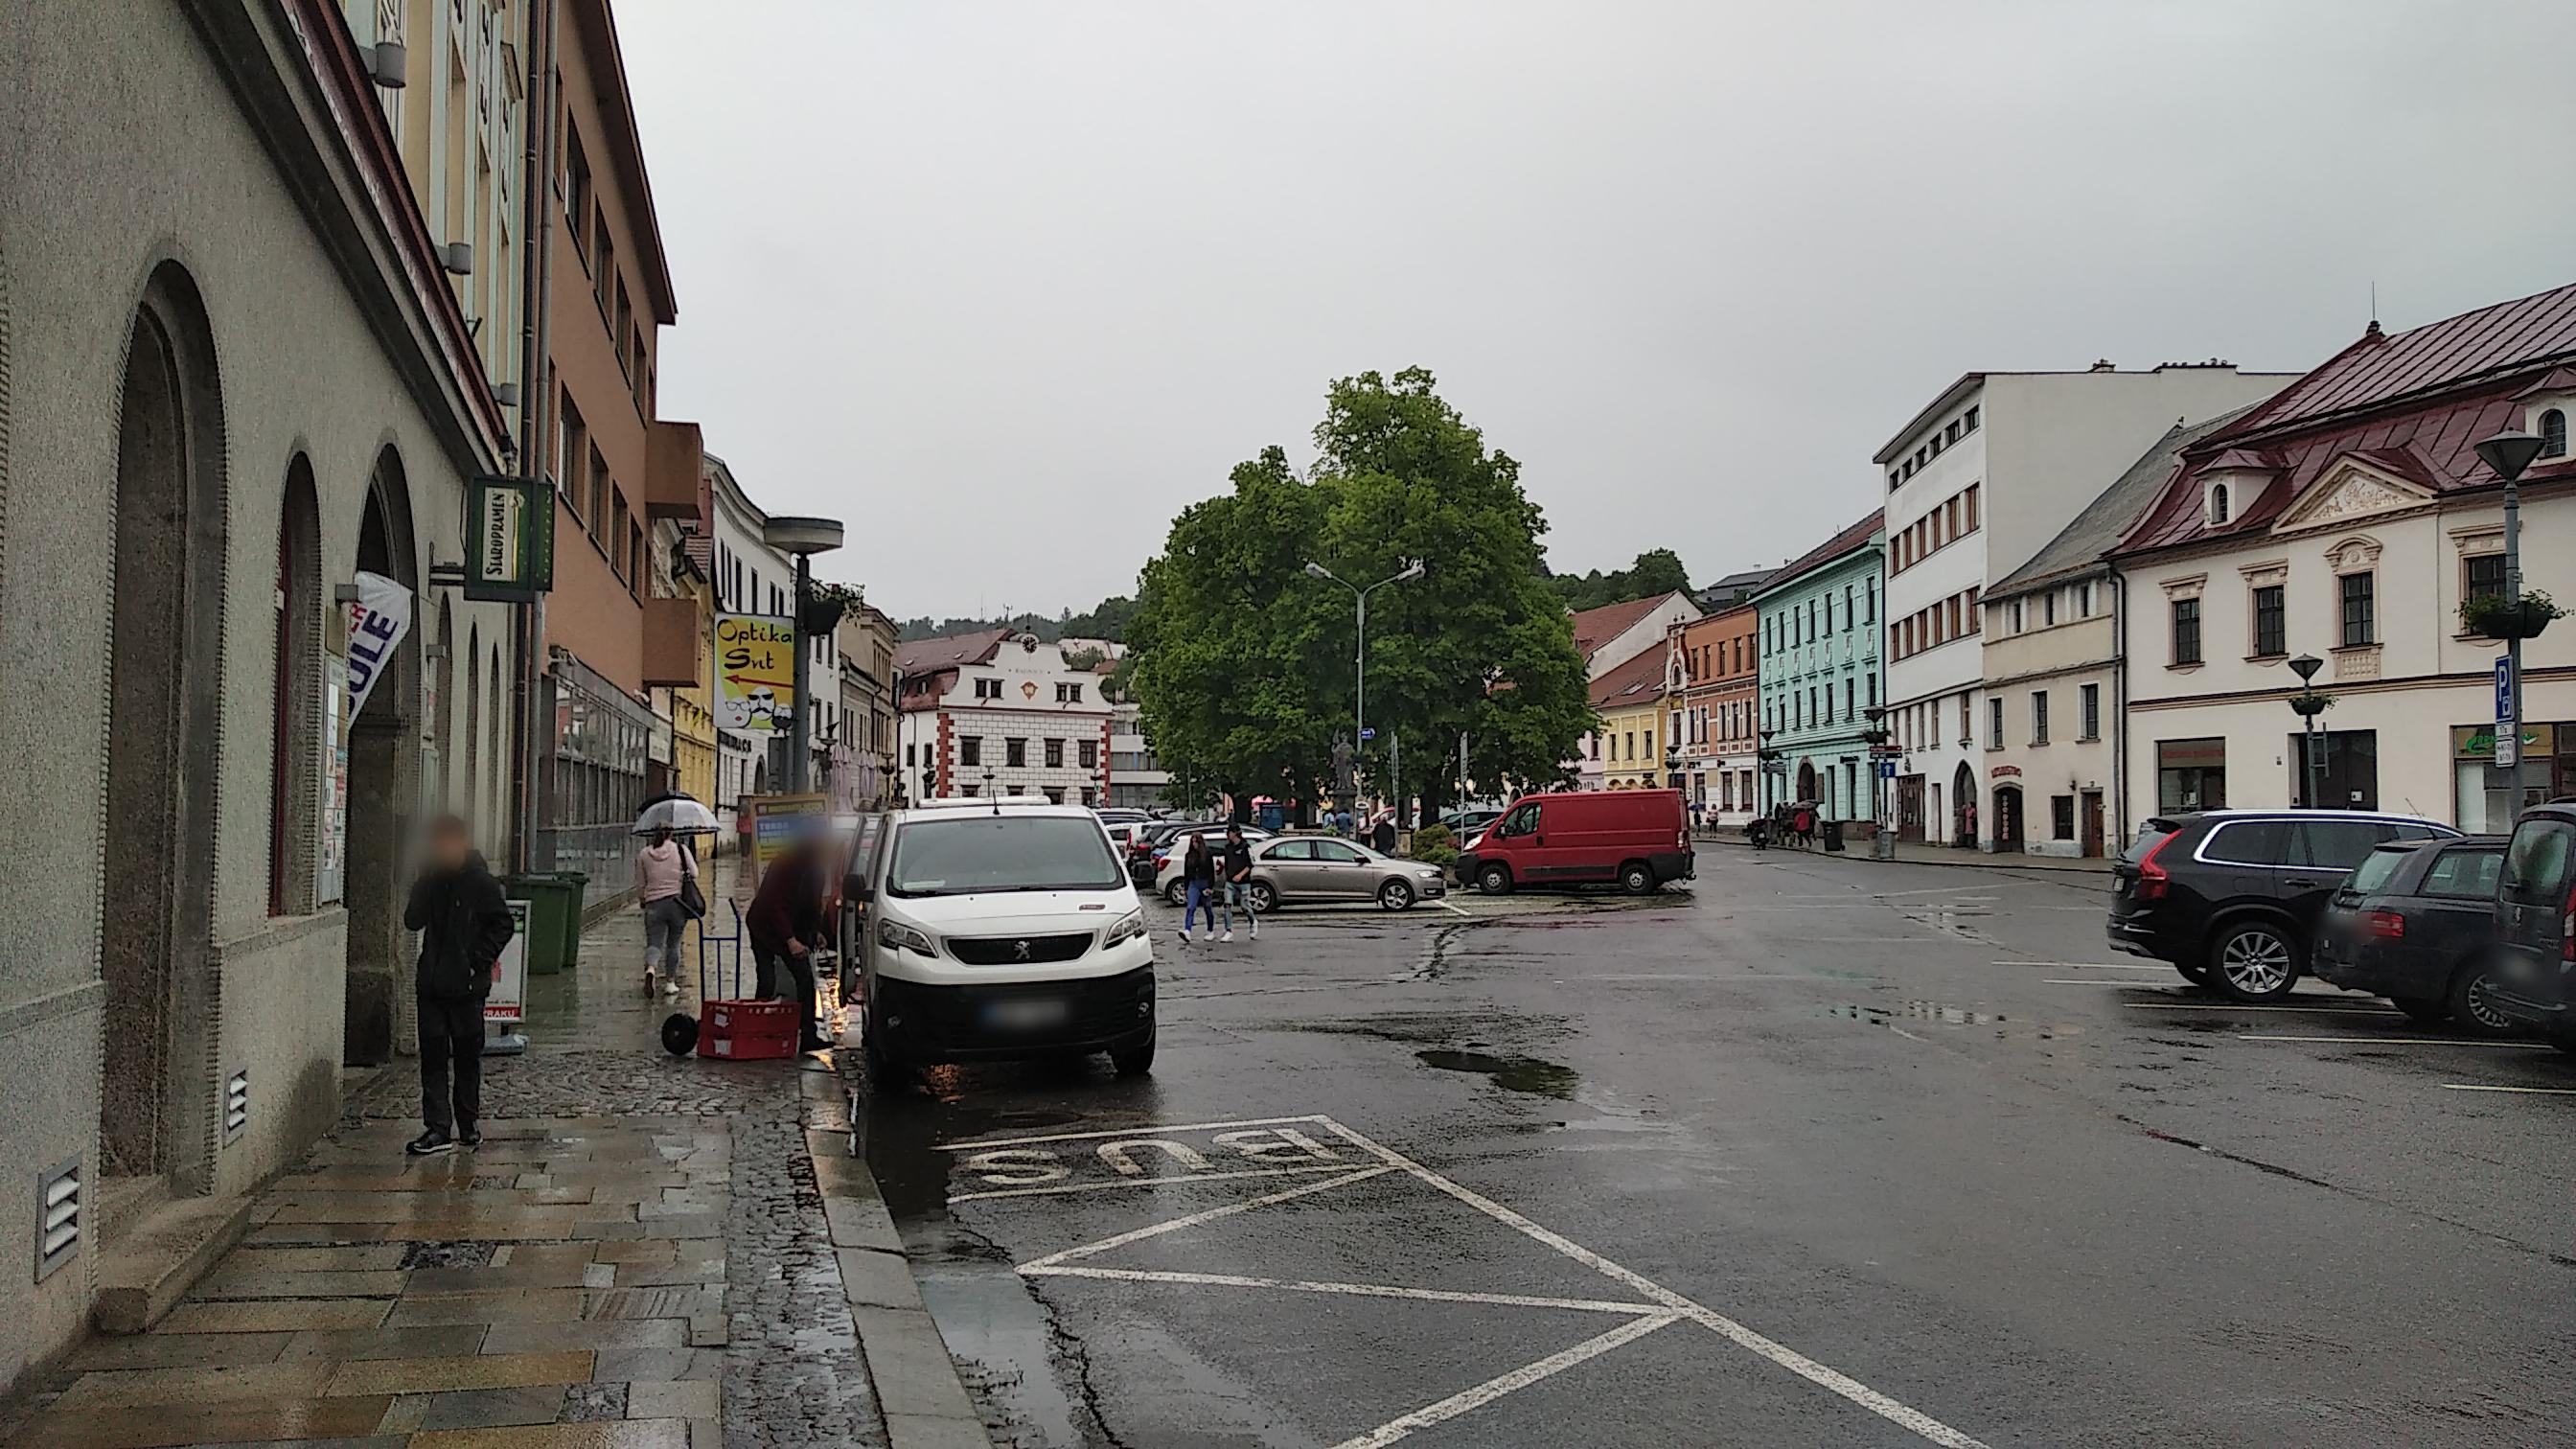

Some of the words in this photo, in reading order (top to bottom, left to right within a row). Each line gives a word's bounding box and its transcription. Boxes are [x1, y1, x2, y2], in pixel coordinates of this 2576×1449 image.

[486, 493, 505, 575] STAROPRAMEN
[717, 619, 793, 645] Optika
[2498, 665, 2508, 702] P
[967, 1127, 1341, 1184] BUS
